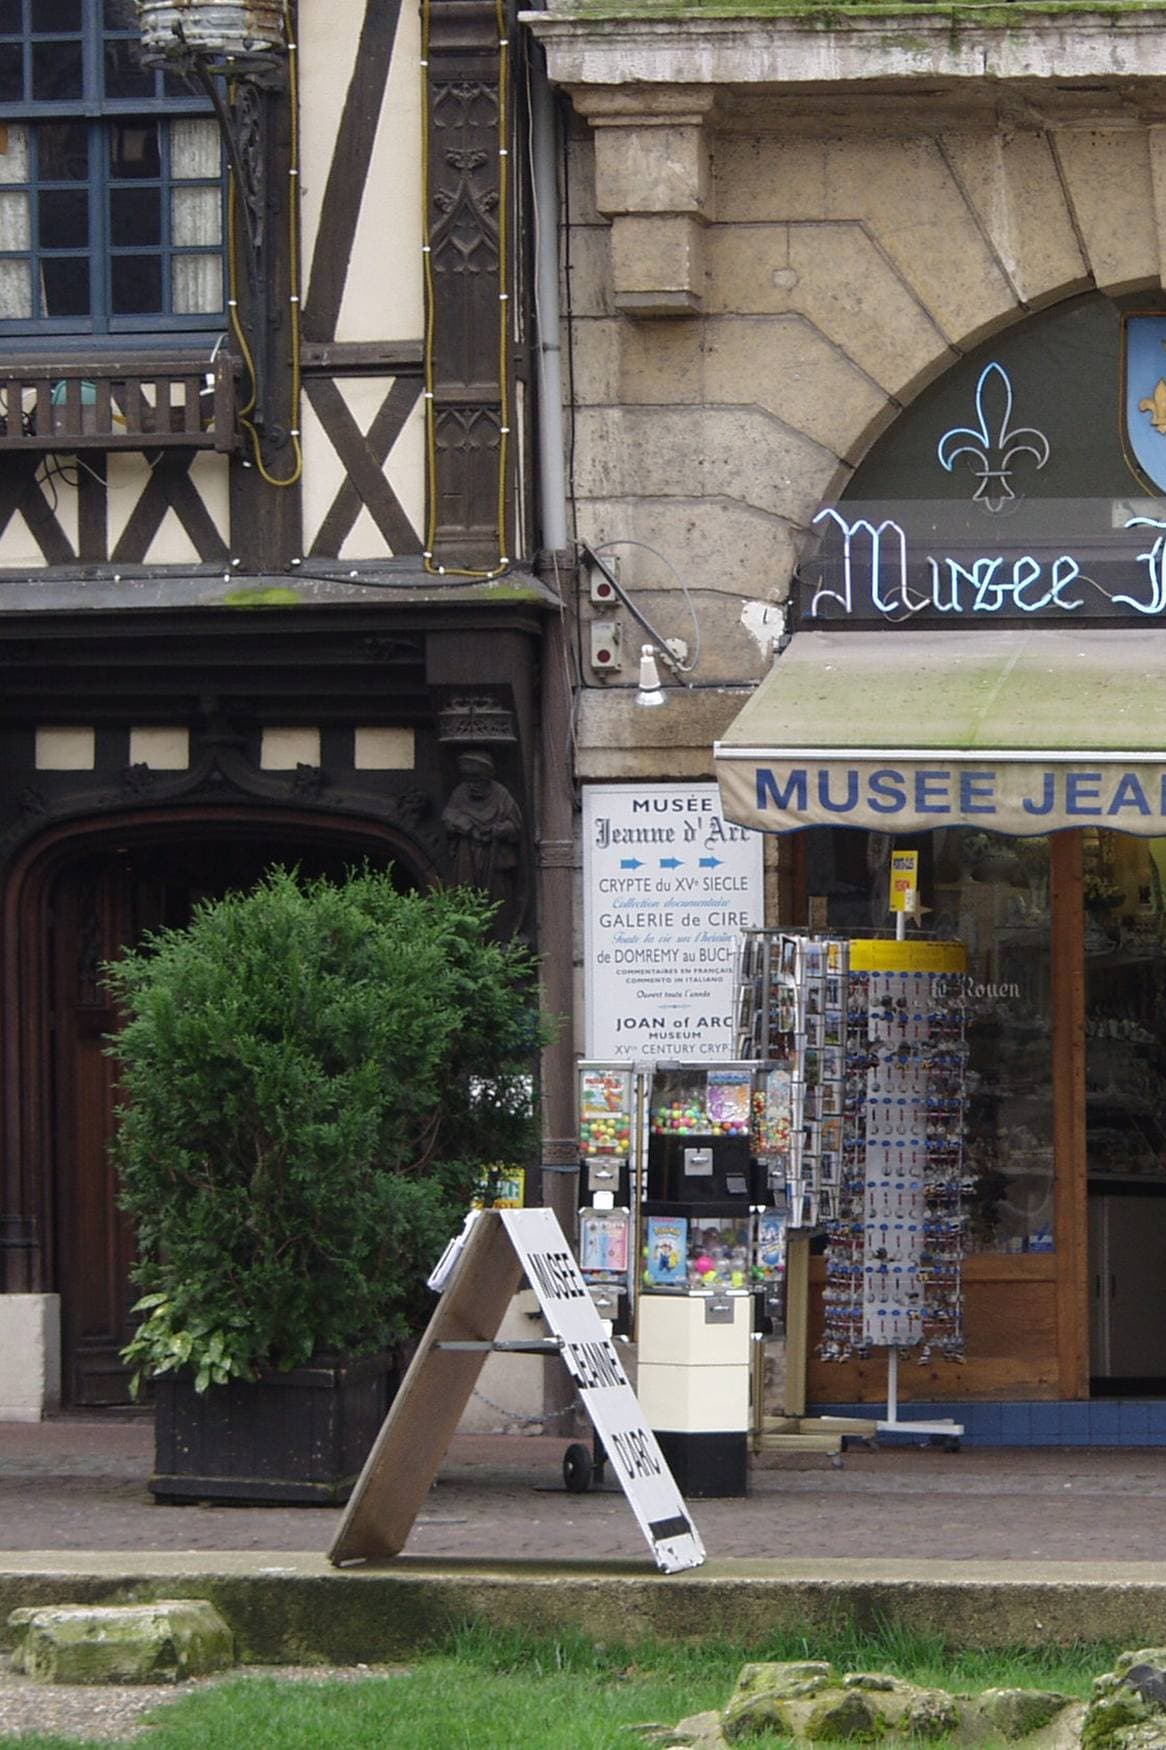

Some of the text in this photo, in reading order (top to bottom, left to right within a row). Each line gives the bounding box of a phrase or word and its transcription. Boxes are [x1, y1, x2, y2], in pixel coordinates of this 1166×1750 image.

[754, 768, 997, 814] MUSEE
[594, 816, 751, 850] Jeanne d'Arc
[599, 878, 651, 893] CRYPTE
[655, 878, 671, 892] du
[703, 876, 748, 892] SIECLE
[599, 911, 749, 928] GALERIE de CIRE
[597, 951, 611, 963] de
[614, 949, 679, 963] DOMREMY
[682, 952, 696, 963] au
[961, 976, 1020, 998] Rouen
[616, 1016, 733, 1032] JOAN of ARC
[641, 1044, 696, 1055] CENTURY
[527, 1252, 586, 1299] MUSEE
